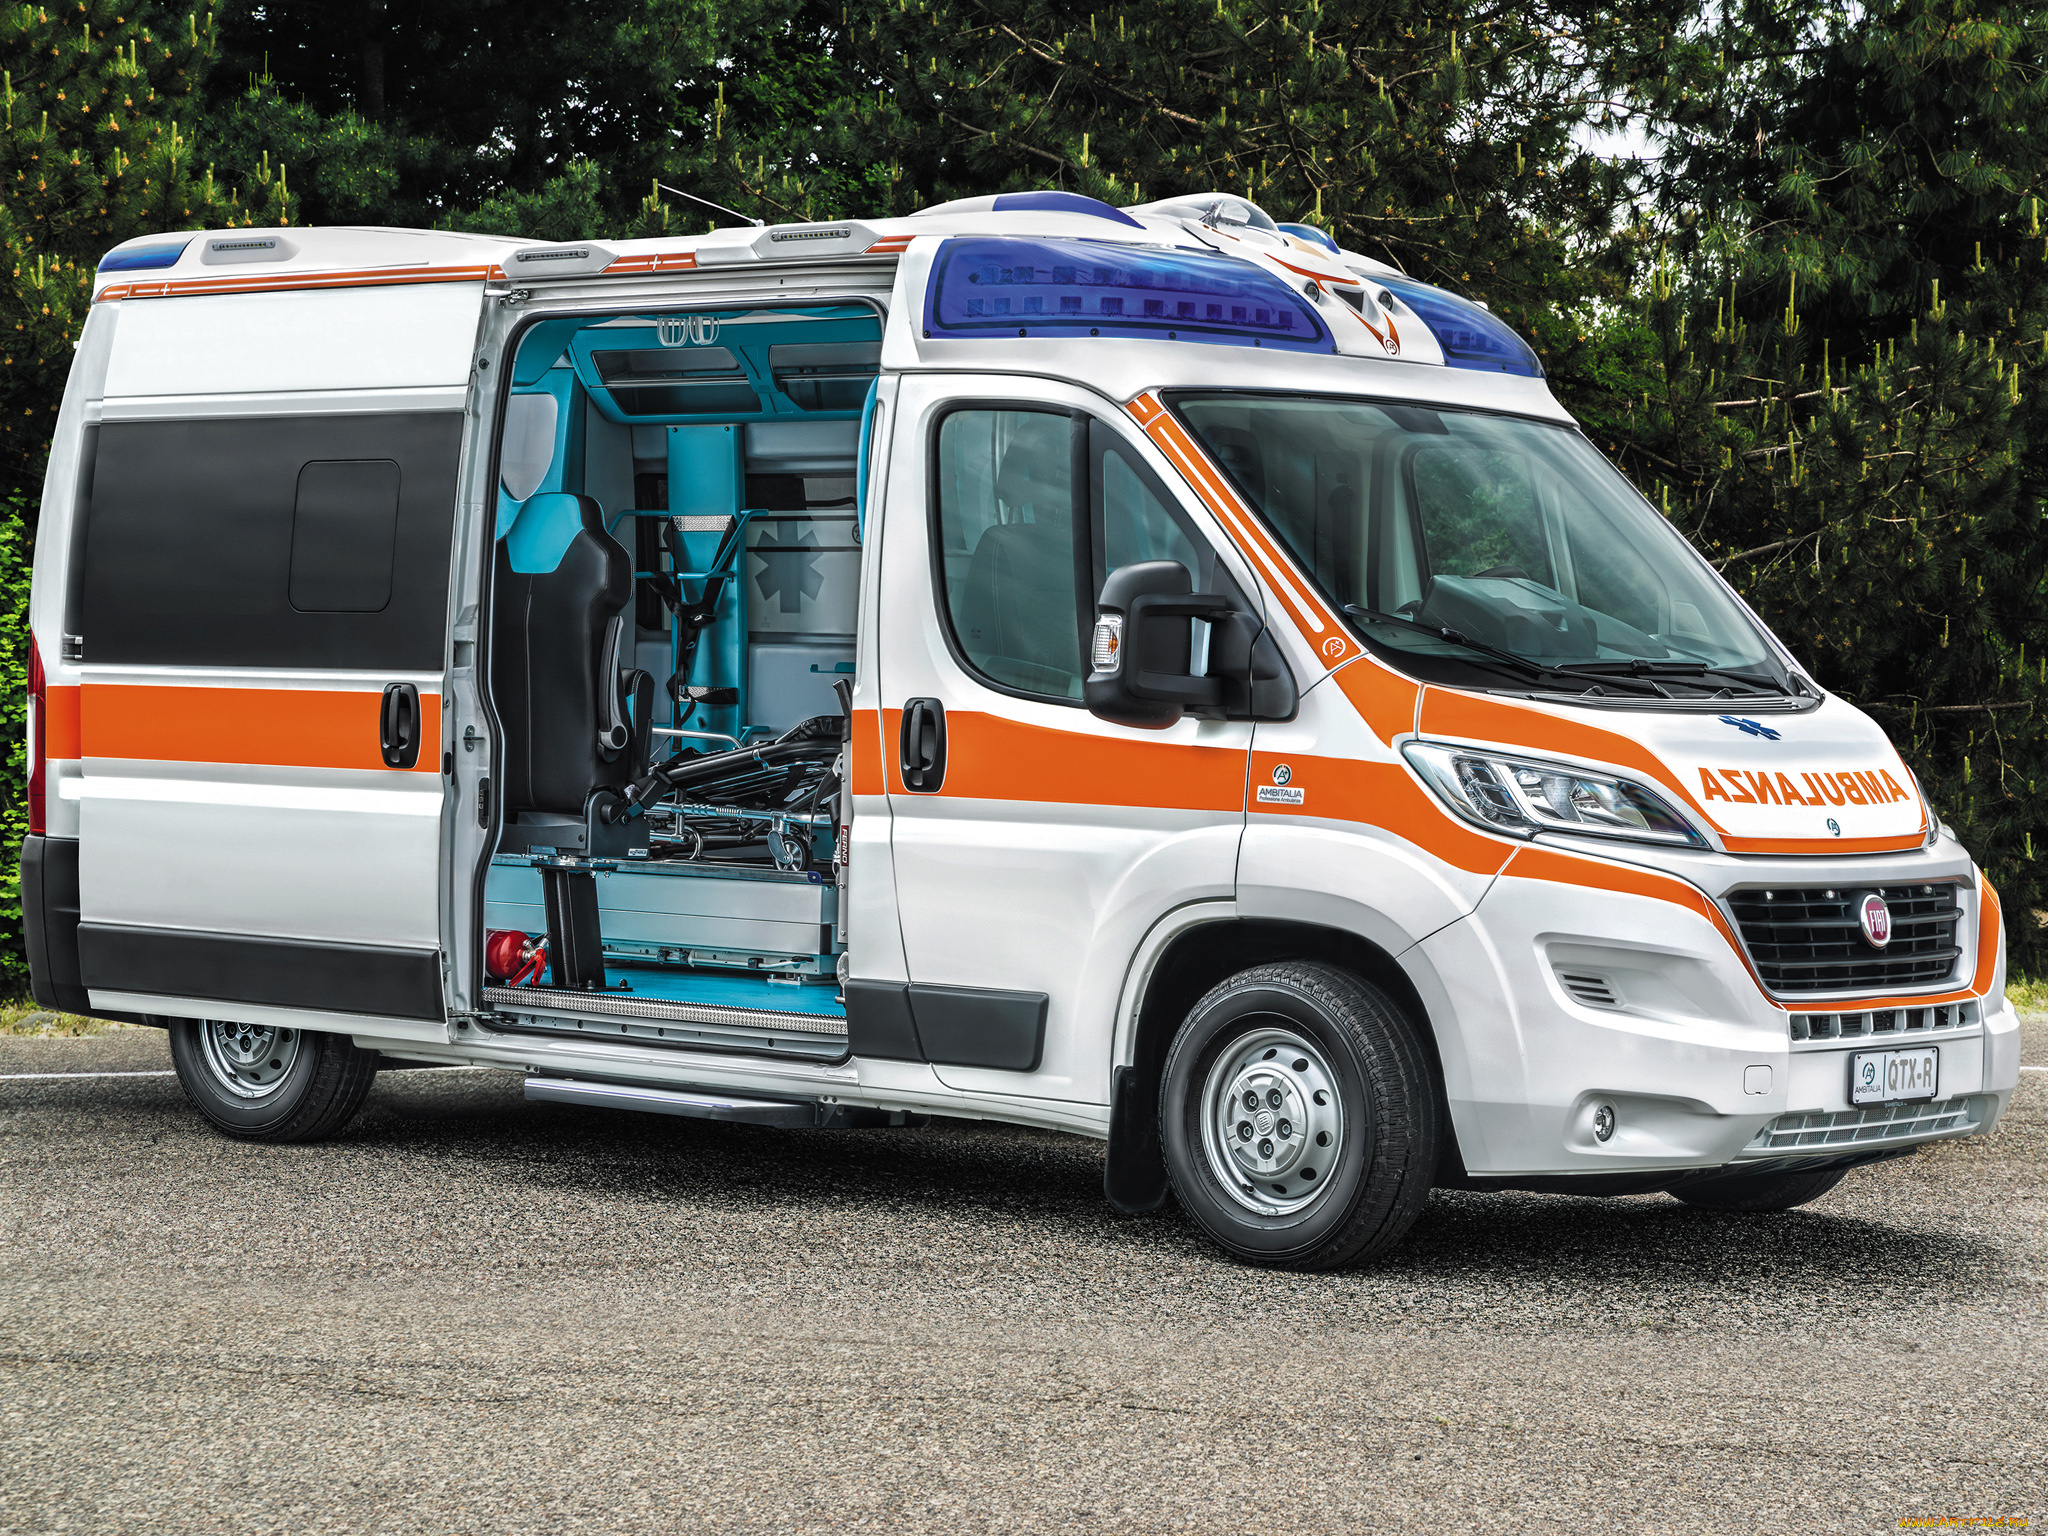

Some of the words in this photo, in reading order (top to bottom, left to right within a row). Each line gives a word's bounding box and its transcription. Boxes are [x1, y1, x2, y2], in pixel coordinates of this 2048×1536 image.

[1259, 788, 1302, 798] AMBITALIA
[1868, 909, 1886, 932] FIAT
[1887, 1057, 1933, 1092] QTX-R
[1854, 1085, 1881, 1094] AMBITALIA
